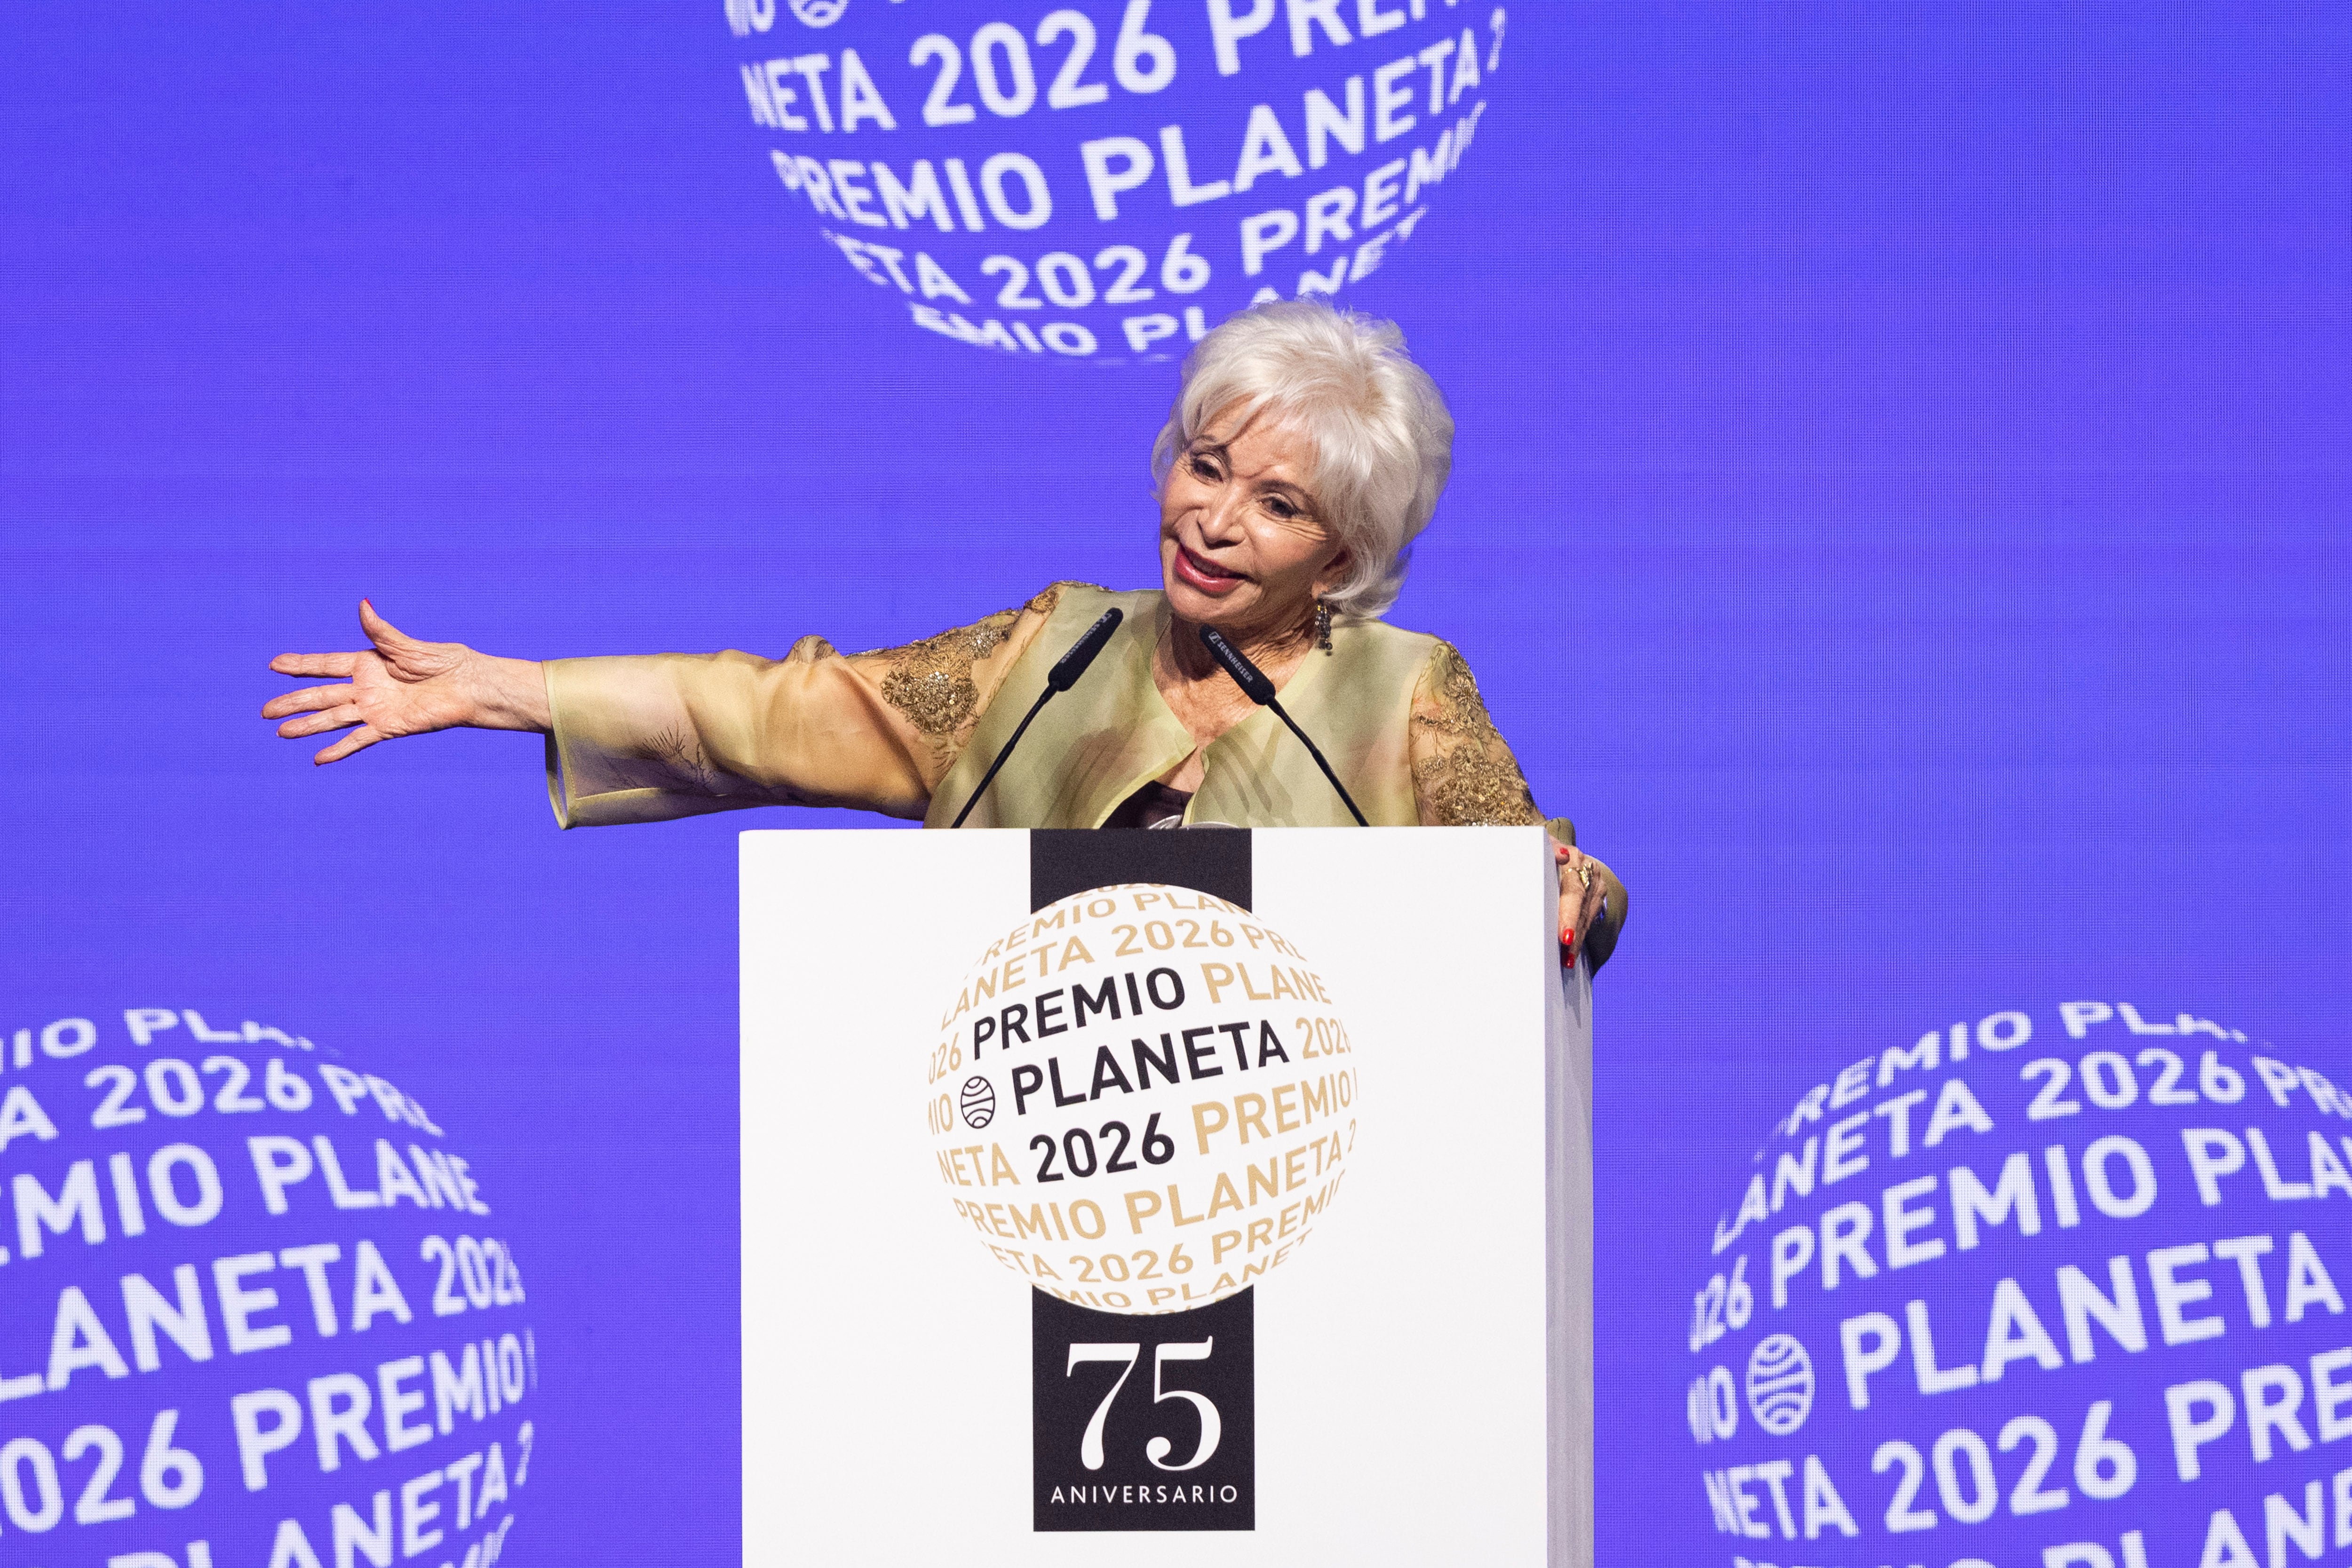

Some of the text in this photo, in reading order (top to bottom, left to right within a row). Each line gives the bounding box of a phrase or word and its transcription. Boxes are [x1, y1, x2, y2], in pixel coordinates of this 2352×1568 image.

[910, 0, 1176, 126] 2026
[771, 151, 1052, 231] PREMIO
[1081, 29, 1479, 221] PLANETA
[826, 232, 971, 304] ETA
[981, 233, 1210, 309] 2026
[1217, 641, 1253, 683] SENNHEISER
[941, 935, 1095, 1031] LANETA
[1112, 919, 1234, 957] 2026
[973, 892, 1262, 966] REMIO PLAN
[0, 1019, 96, 1072] IO
[975, 968, 1184, 1060] PREMIO
[1200, 963, 1332, 1004] PLANE
[1012, 1020, 1289, 1115] PLANETA
[85, 1056, 312, 1128] 2026
[937, 1142, 1020, 1186] NETA
[1030, 1113, 1174, 1182] 2026
[1192, 1071, 1351, 1155] PREMIO
[0, 1143, 223, 1265] MIO
[954, 1198, 1106, 1241] PREMIO
[1124, 1131, 1342, 1234] PLANETA
[1712, 1079, 1994, 1254] LANETA
[2021, 1049, 2245, 1121] 2026
[982, 1241, 1062, 1281] ETA
[1069, 1243, 1193, 1282] 2026
[1772, 1136, 2156, 1308] PREMIO
[2182, 1128, 2352, 1206] PLA
[1840, 1232, 2344, 1409] PLANETA
[0, 1409, 203, 1532] 026
[231, 1334, 524, 1491] PREMIO
[1067, 1336, 1221, 1471] 75
[1872, 1401, 2137, 1532] 2026
[2165, 1347, 2352, 1480] PRE
[1051, 1486, 1237, 1503] ANIVERSARIO
